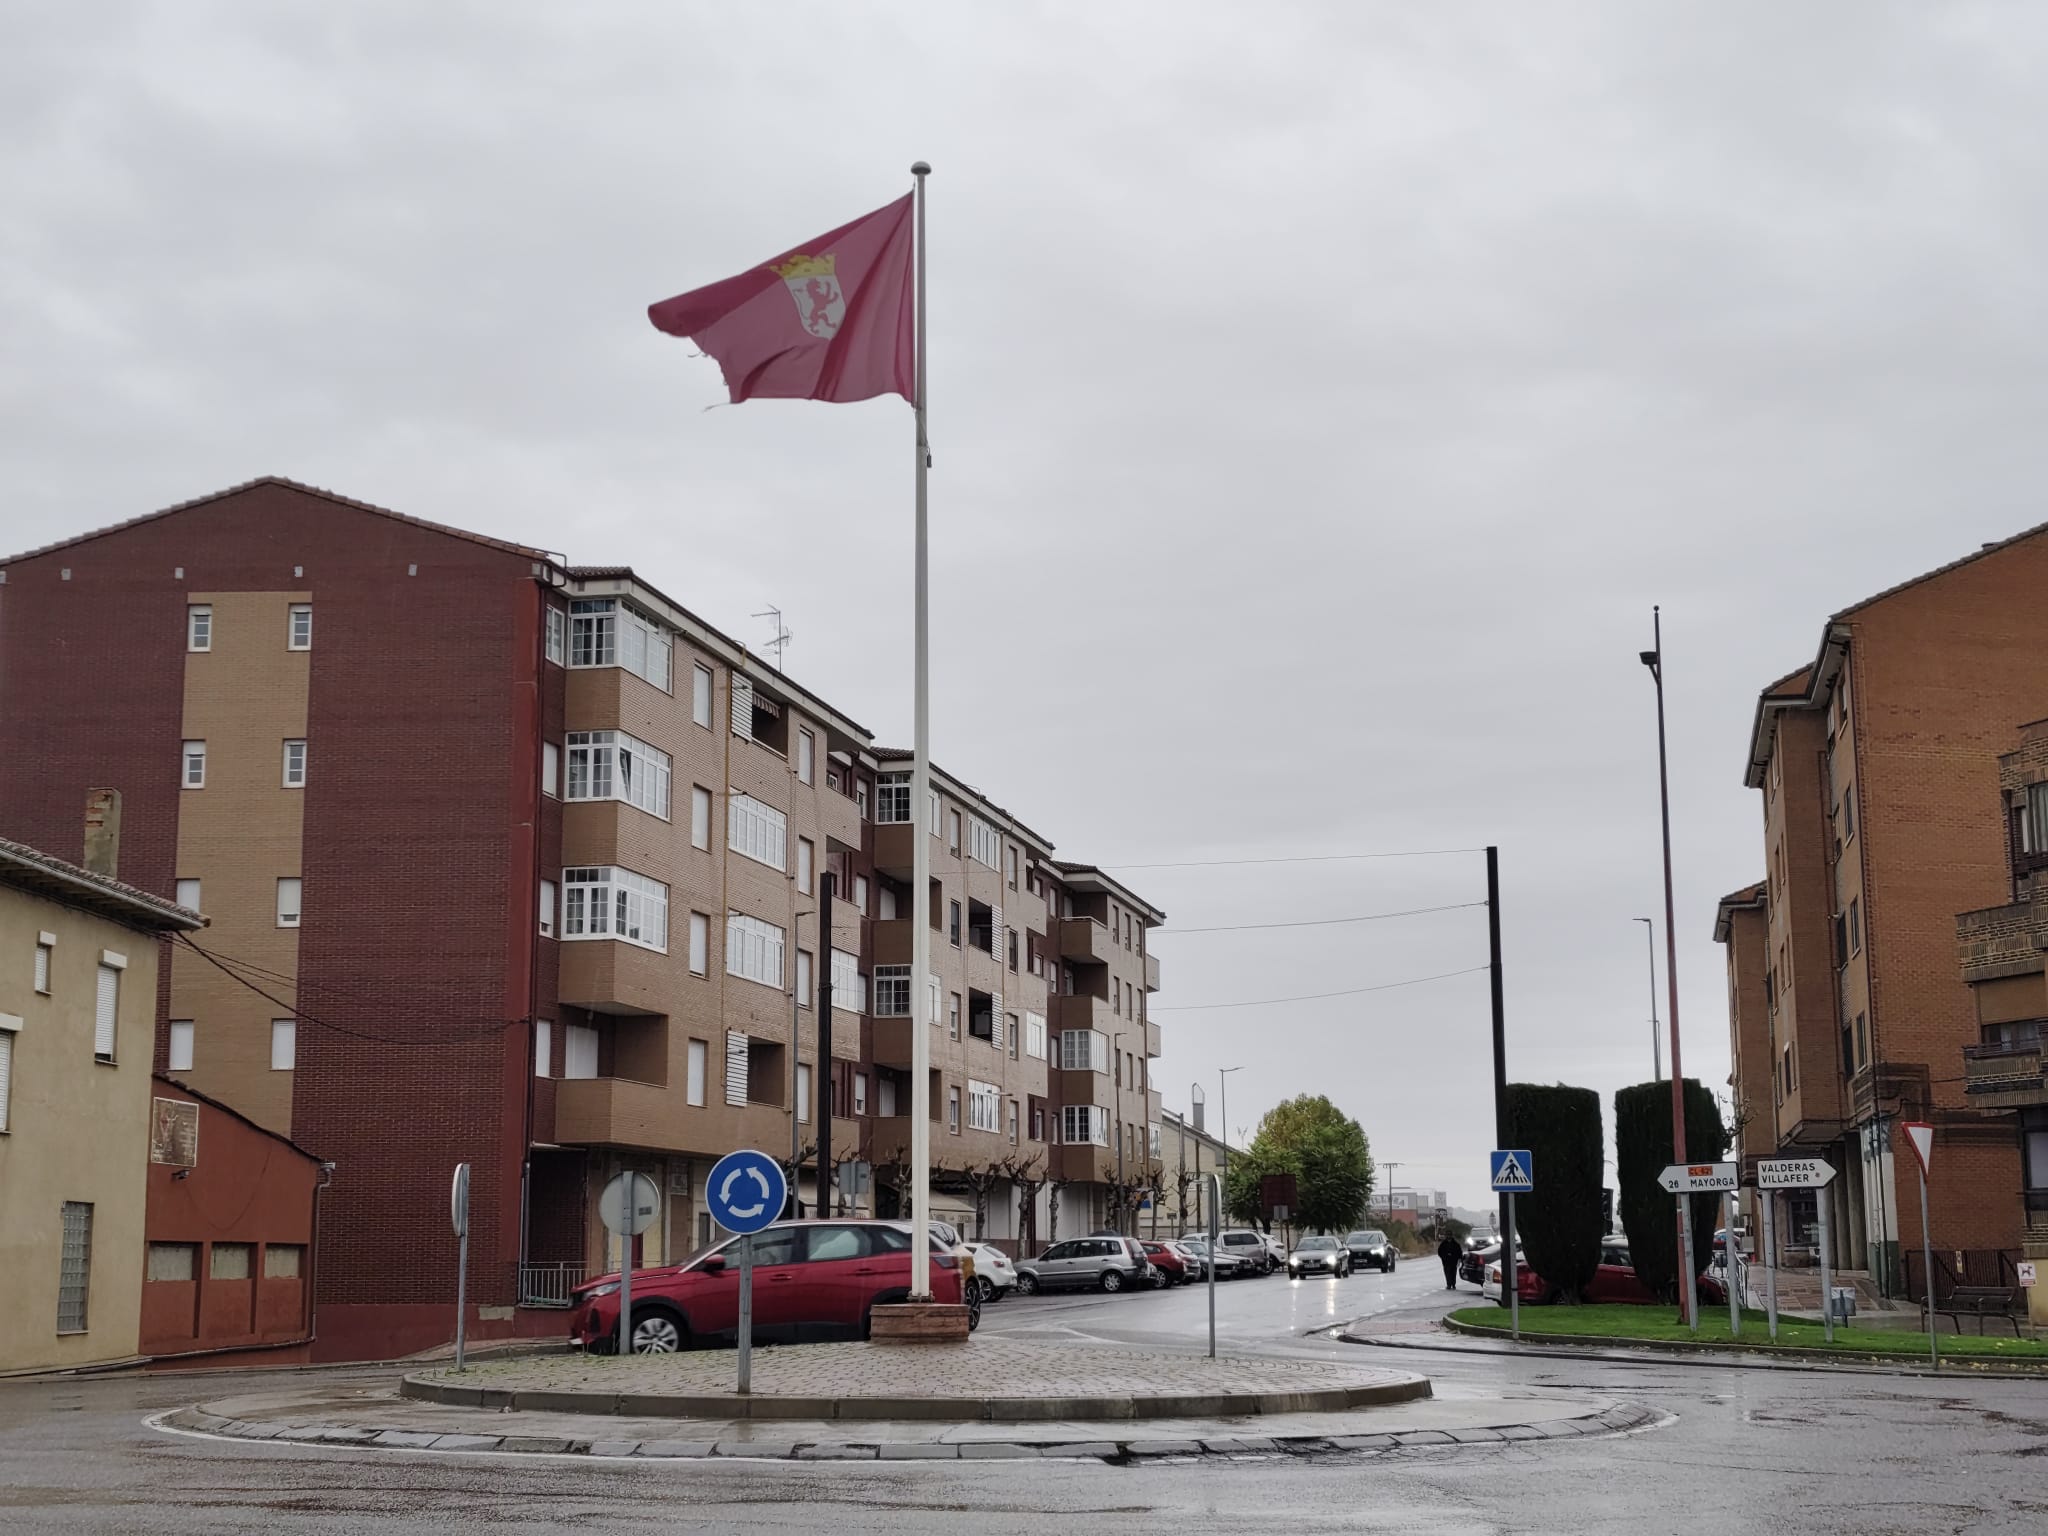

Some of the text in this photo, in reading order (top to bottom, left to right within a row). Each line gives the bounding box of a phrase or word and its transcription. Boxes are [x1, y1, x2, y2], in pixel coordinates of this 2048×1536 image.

[1761, 1163, 1816, 1173] VALDERAS
[1668, 1177, 1735, 1188] 26 MAYORGA
[1762, 1173, 1809, 1183] VILLAFER
